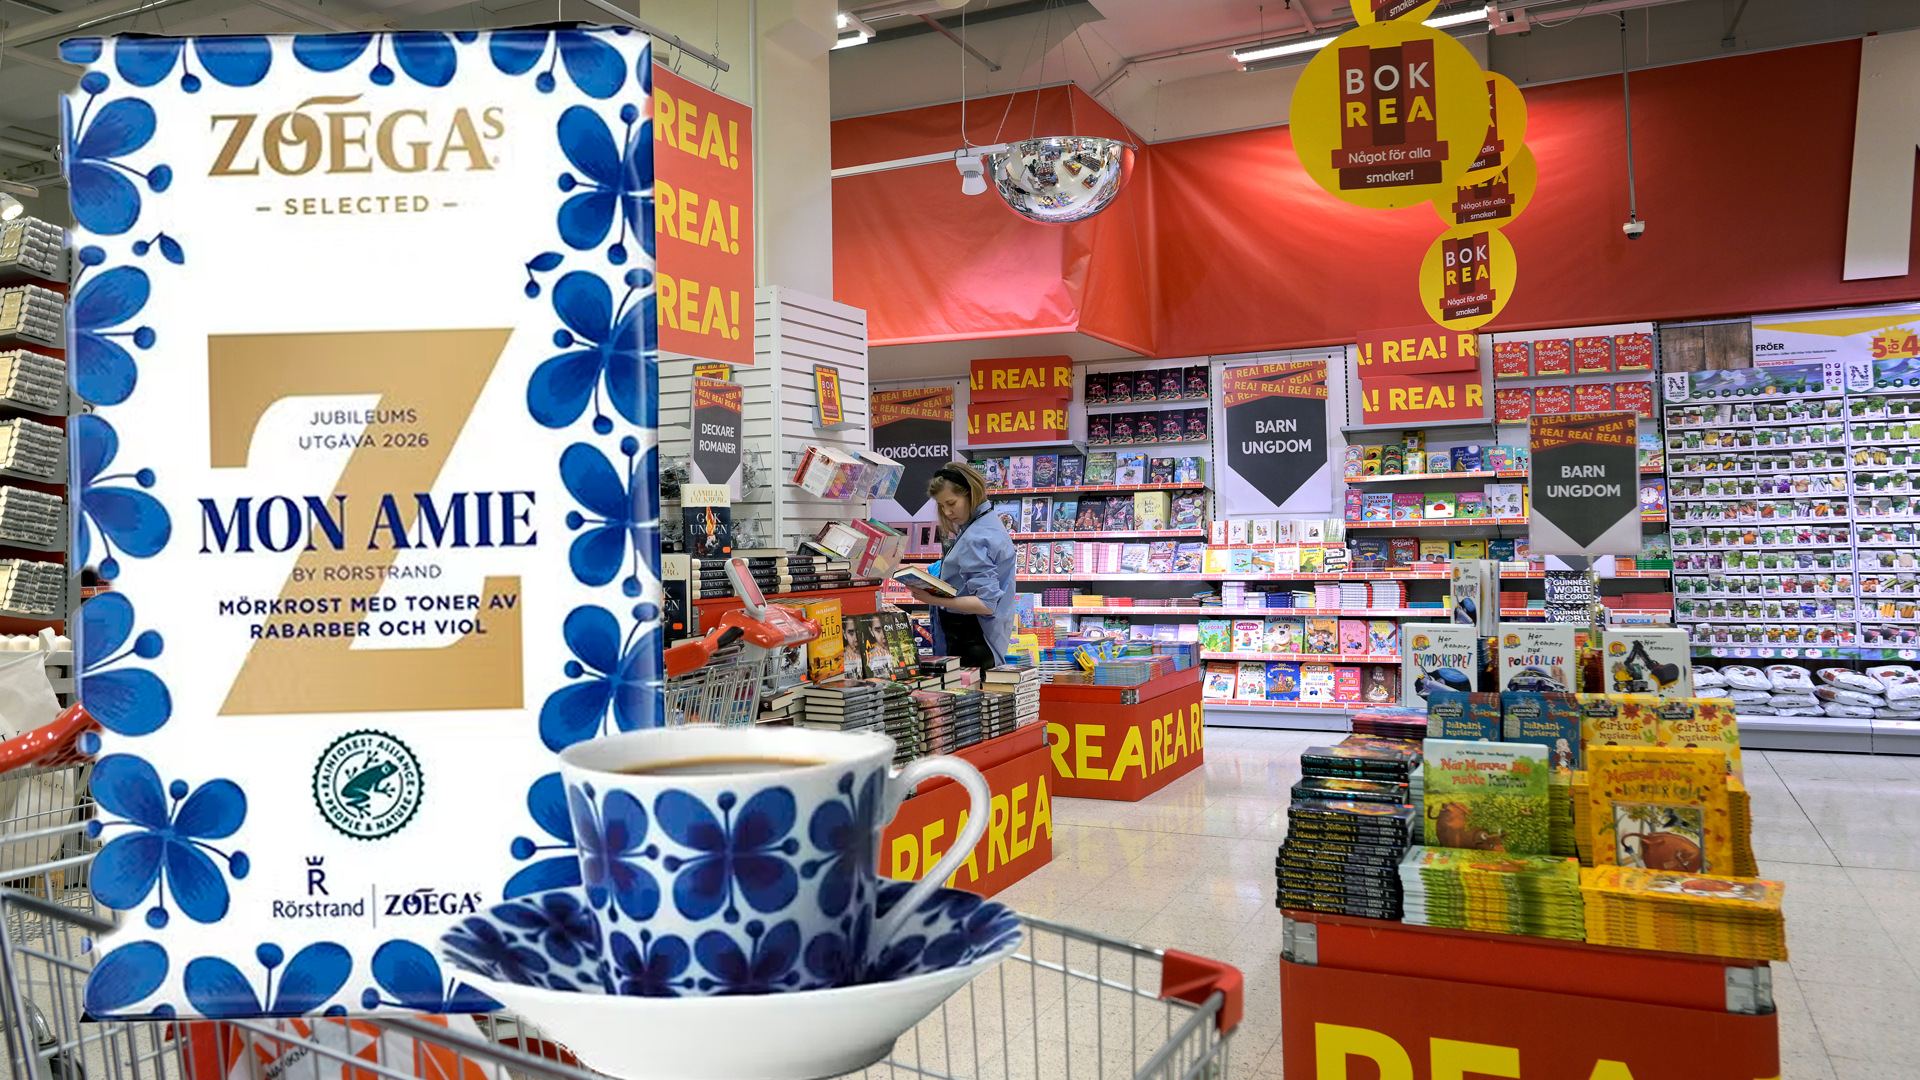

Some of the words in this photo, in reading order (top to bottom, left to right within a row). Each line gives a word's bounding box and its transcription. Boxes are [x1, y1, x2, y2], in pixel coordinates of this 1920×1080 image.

[1389, 0, 1418, 17] smaker
[1345, 62, 1431, 95] BOK
[1346, 96, 1434, 128] REA
[654, 86, 739, 170] REA!
[1348, 151, 1387, 165] Något
[1389, 149, 1406, 161] för
[1409, 147, 1431, 159] alla
[1481, 144, 1495, 153] alla
[1366, 169, 1414, 184] smaker!
[284, 195, 430, 216] SELECTED
[1460, 202, 1481, 211] Något
[1482, 199, 1492, 207] för
[654, 178, 740, 256] REA!
[1470, 210, 1497, 220] smaker!
[1446, 244, 1488, 267] BOK
[1446, 264, 1489, 286] REA
[656, 272, 740, 341] REA!
[1447, 298, 1466, 306] Något
[1455, 307, 1480, 317] smaker!
[1382, 335, 1448, 364] REA!
[1755, 342, 1785, 351] FRÖER
[1872, 337, 1888, 358] 5
[992, 367, 1045, 390] REA!
[1236, 367, 1259, 378] REA!
[1263, 363, 1286, 373] REA!
[821, 380, 835, 390] BOK
[1234, 381, 1257, 391] REA!
[1261, 383, 1284, 393] REA!
[1288, 385, 1311, 395] REA!
[1389, 385, 1456, 411] REA!
[310, 409, 418, 426] JUBILEUMS
[900, 406, 919, 415] REA!
[922, 409, 940, 418] REA!
[1542, 415, 1566, 425] REA!
[701, 423, 735, 437] DECKARE
[987, 410, 1036, 434] REA!
[1255, 419, 1297, 434] BARN
[298, 433, 377, 450] UTGÅVA
[383, 433, 429, 449] 2026
[1540, 428, 1564, 437] REA!
[1568, 430, 1592, 440] REA!
[1596, 433, 1621, 443] REA!
[699, 439, 736, 454] ROMANER
[876, 443, 949, 459] KOKBÖCKER
[1242, 438, 1312, 455] UNGDOM
[1561, 465, 1605, 478] BARN
[1547, 484, 1621, 498] UNGDOM
[197, 494, 348, 554] MON
[366, 490, 538, 551] AMIE
[293, 566, 317, 582] BY
[324, 563, 442, 582] RÖRSTRAND
[1553, 585, 1591, 593] WORLD
[219, 596, 342, 617] MÖRKROST
[350, 596, 397, 613] MED
[405, 595, 480, 612] TONER
[489, 594, 518, 610] AV
[250, 622, 370, 640] RABARBER
[379, 620, 426, 637] OCH
[435, 619, 487, 636] VIOL
[820, 616, 835, 626] LEE
[821, 625, 841, 638] HILD
[1413, 652, 1473, 669] RYMDSKEPPET
[1508, 655, 1564, 668] POLISBILEN
[1151, 709, 1188, 775] REA
[1051, 723, 1148, 782] REA
[322, 738, 373, 789] RAINFOREST
[376, 739, 415, 787] ALLIANCE
[1440, 757, 1464, 771] När
[1465, 758, 1508, 772] Mamma
[325, 798, 361, 832] PEOPLE
[365, 823, 373, 832] &
[376, 796, 412, 832] NATURE
[987, 775, 1053, 875] REA
[307, 868, 329, 896] R
[272, 897, 365, 919] Rörstrand
